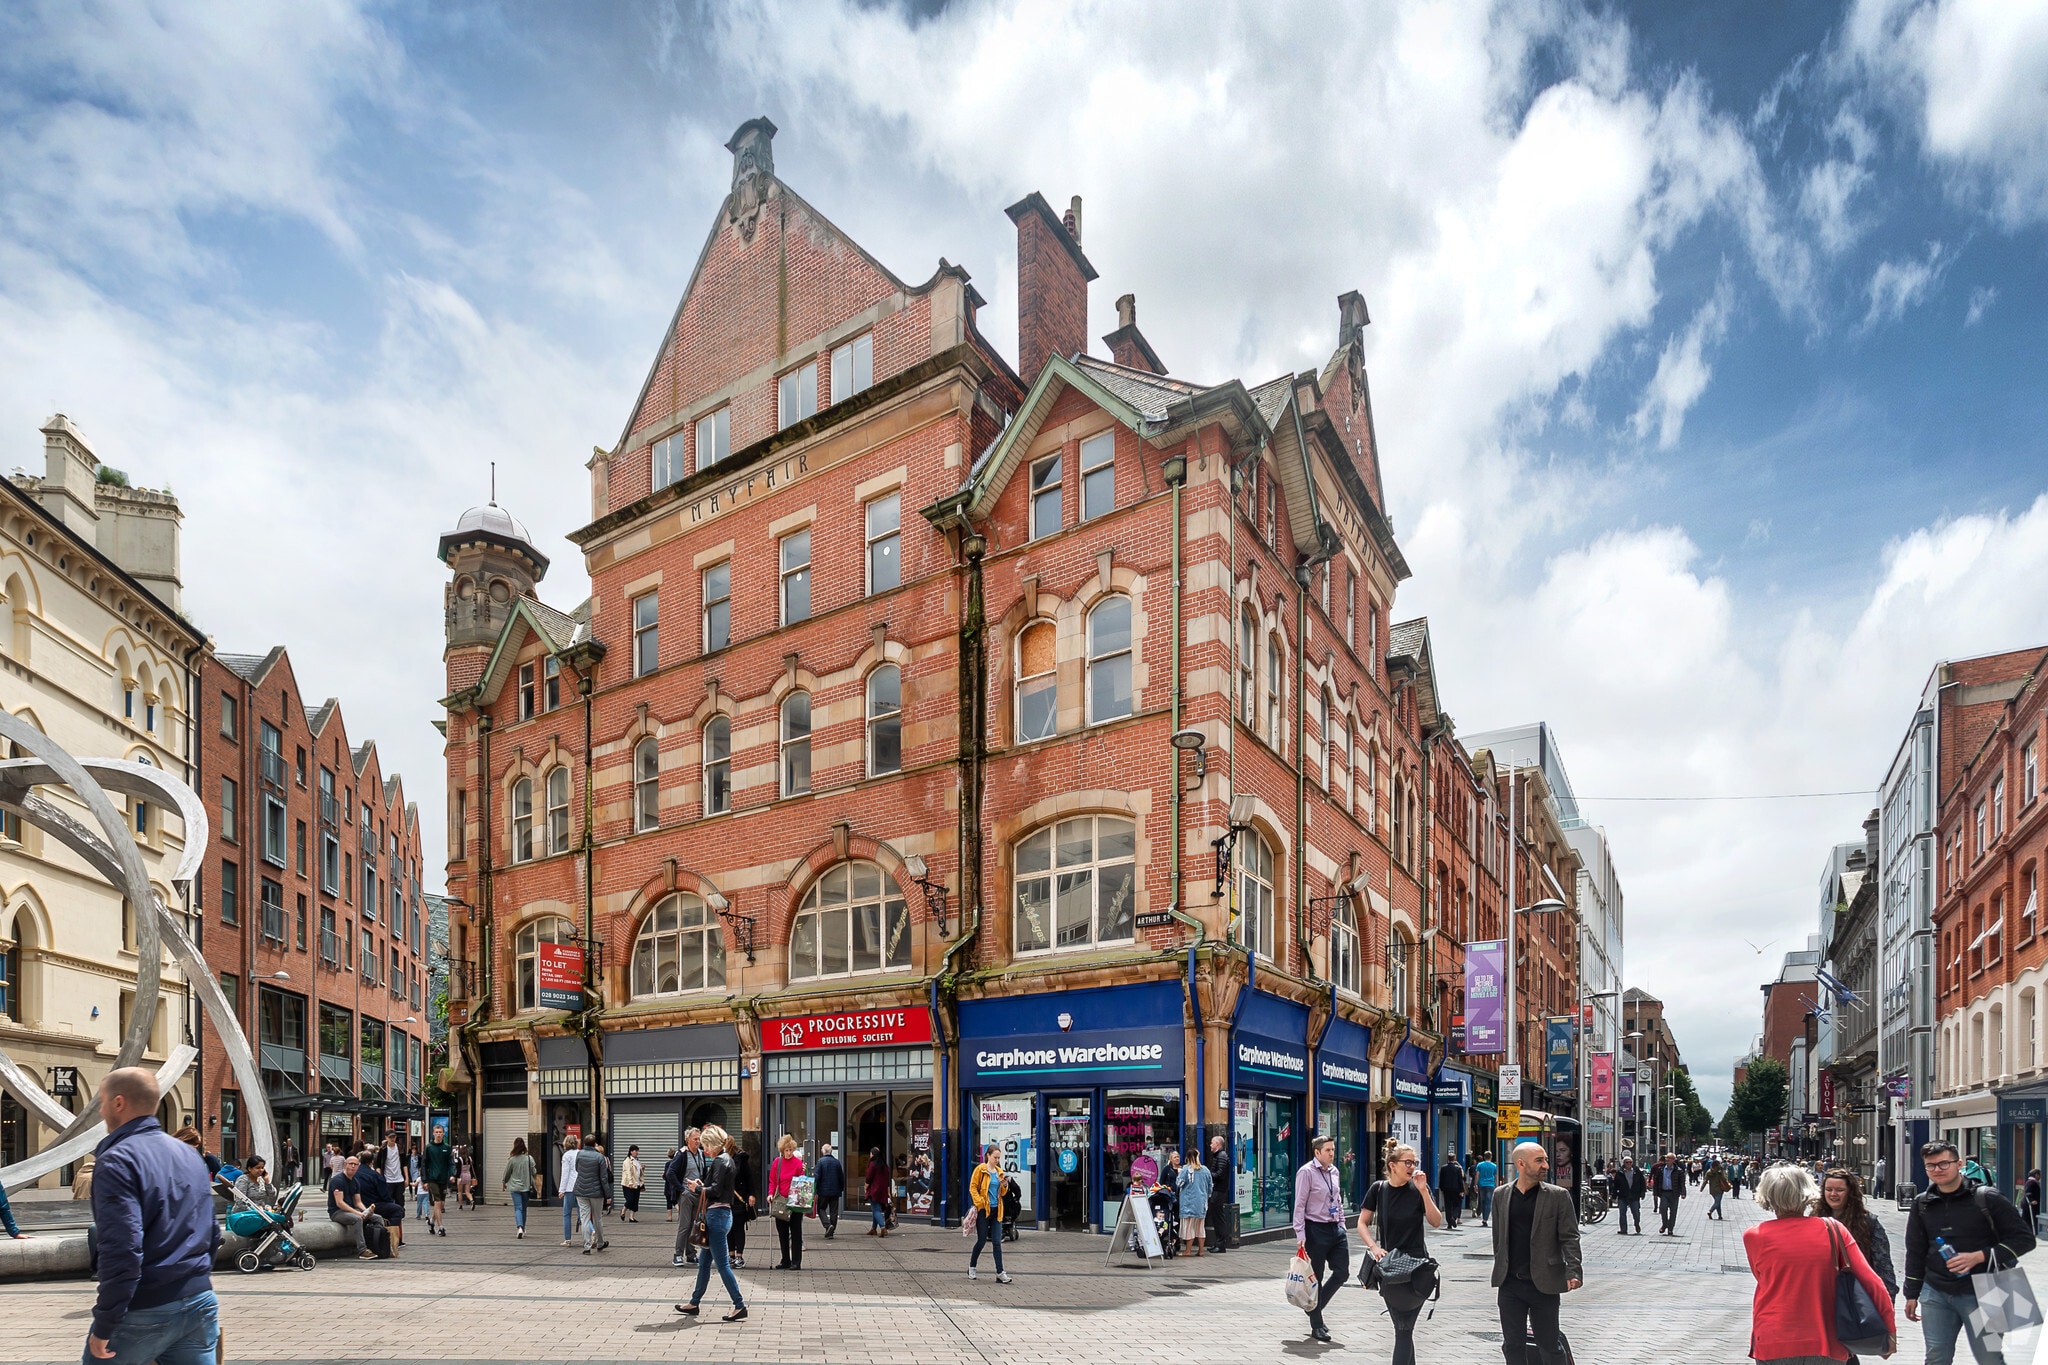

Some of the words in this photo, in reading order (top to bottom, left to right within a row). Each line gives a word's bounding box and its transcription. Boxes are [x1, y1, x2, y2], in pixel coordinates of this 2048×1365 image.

[691, 454, 809, 523] MAYFAIR
[1137, 915, 1161, 925] ARTHUR
[541, 959, 553, 968] TO
[553, 961, 567, 969] LET
[809, 1013, 905, 1033] PROGRESSIVE
[821, 1035, 857, 1045] BUILDING
[862, 1033, 894, 1042] SOCIETY
[976, 1048, 1056, 1069] Carphone
[1058, 1043, 1163, 1064] Warehouse
[1238, 1043, 1271, 1065] Carphone
[1270, 1051, 1304, 1072] Warehouse
[1322, 1062, 1345, 1080] Carphone
[1343, 1067, 1368, 1085] Warehouse
[1395, 1078, 1412, 1093] Carphone
[1410, 1082, 1428, 1096] Warehouse
[226, 1101, 234, 1124] 2
[982, 1103, 996, 1111] PULL
[996, 1103, 1001, 1111] A
[2008, 1109, 2040, 1117] SEASALT
[982, 1112, 1018, 1121] SWITCHEROO
[1107, 1122, 1152, 1135] mobile
